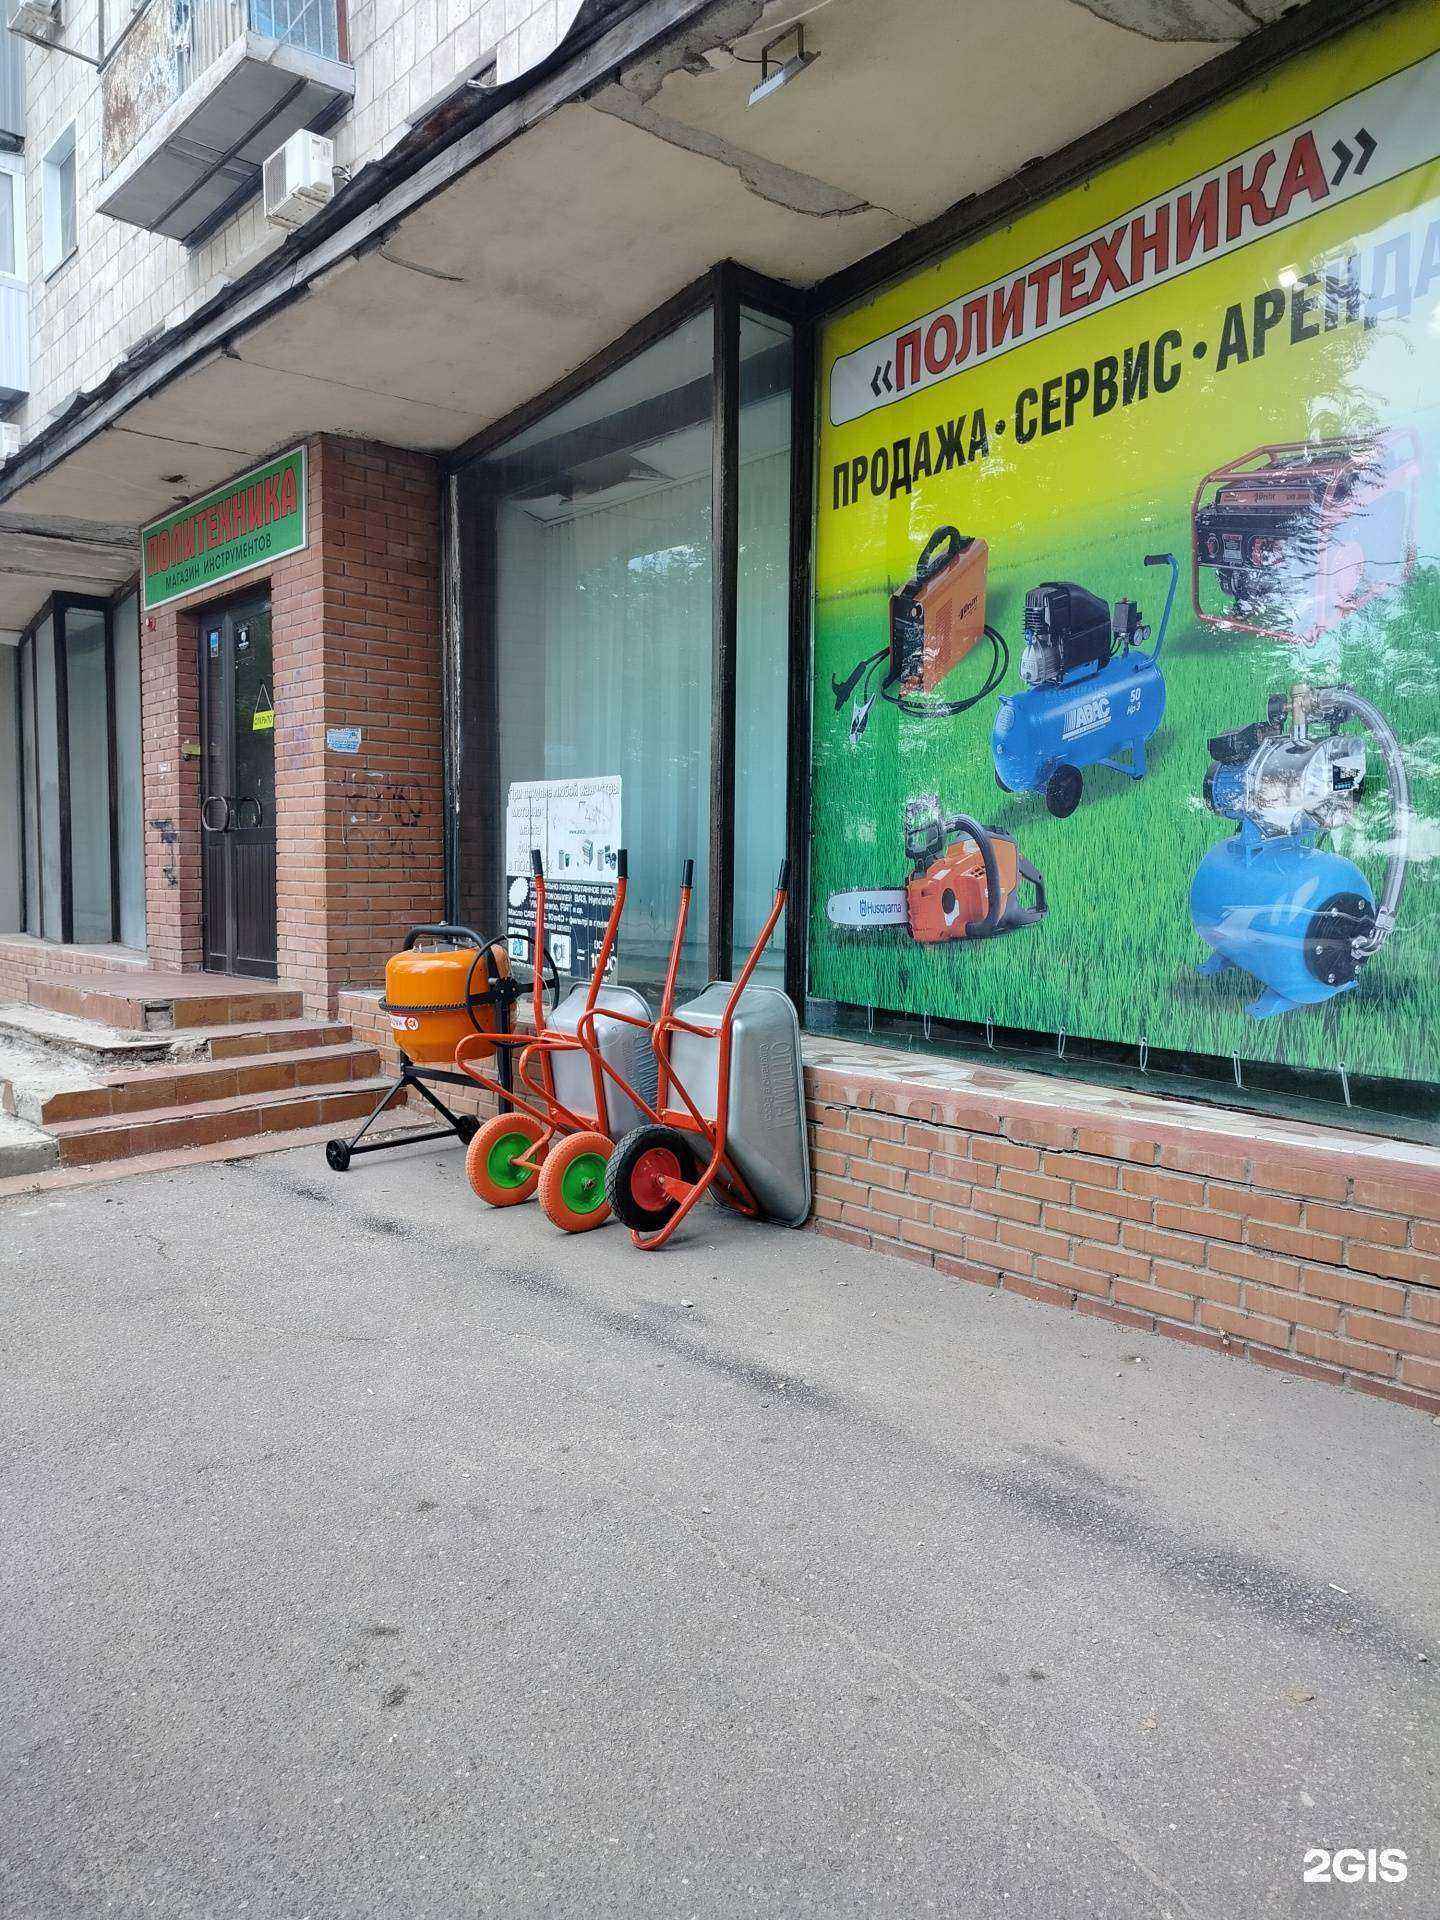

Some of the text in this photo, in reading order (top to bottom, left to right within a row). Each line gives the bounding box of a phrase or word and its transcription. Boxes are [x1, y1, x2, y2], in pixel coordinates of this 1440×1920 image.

[832, 408, 989, 510] ПРОДАЖА
[1015, 329, 1182, 445] СЕРВИС
[146, 467, 297, 577] ПОЛИТЕХНИКА
[166, 533, 272, 591] МАГАЗИН ИНСТРУМЕНТОВ
[866, 902, 902, 916] Husqvarna
